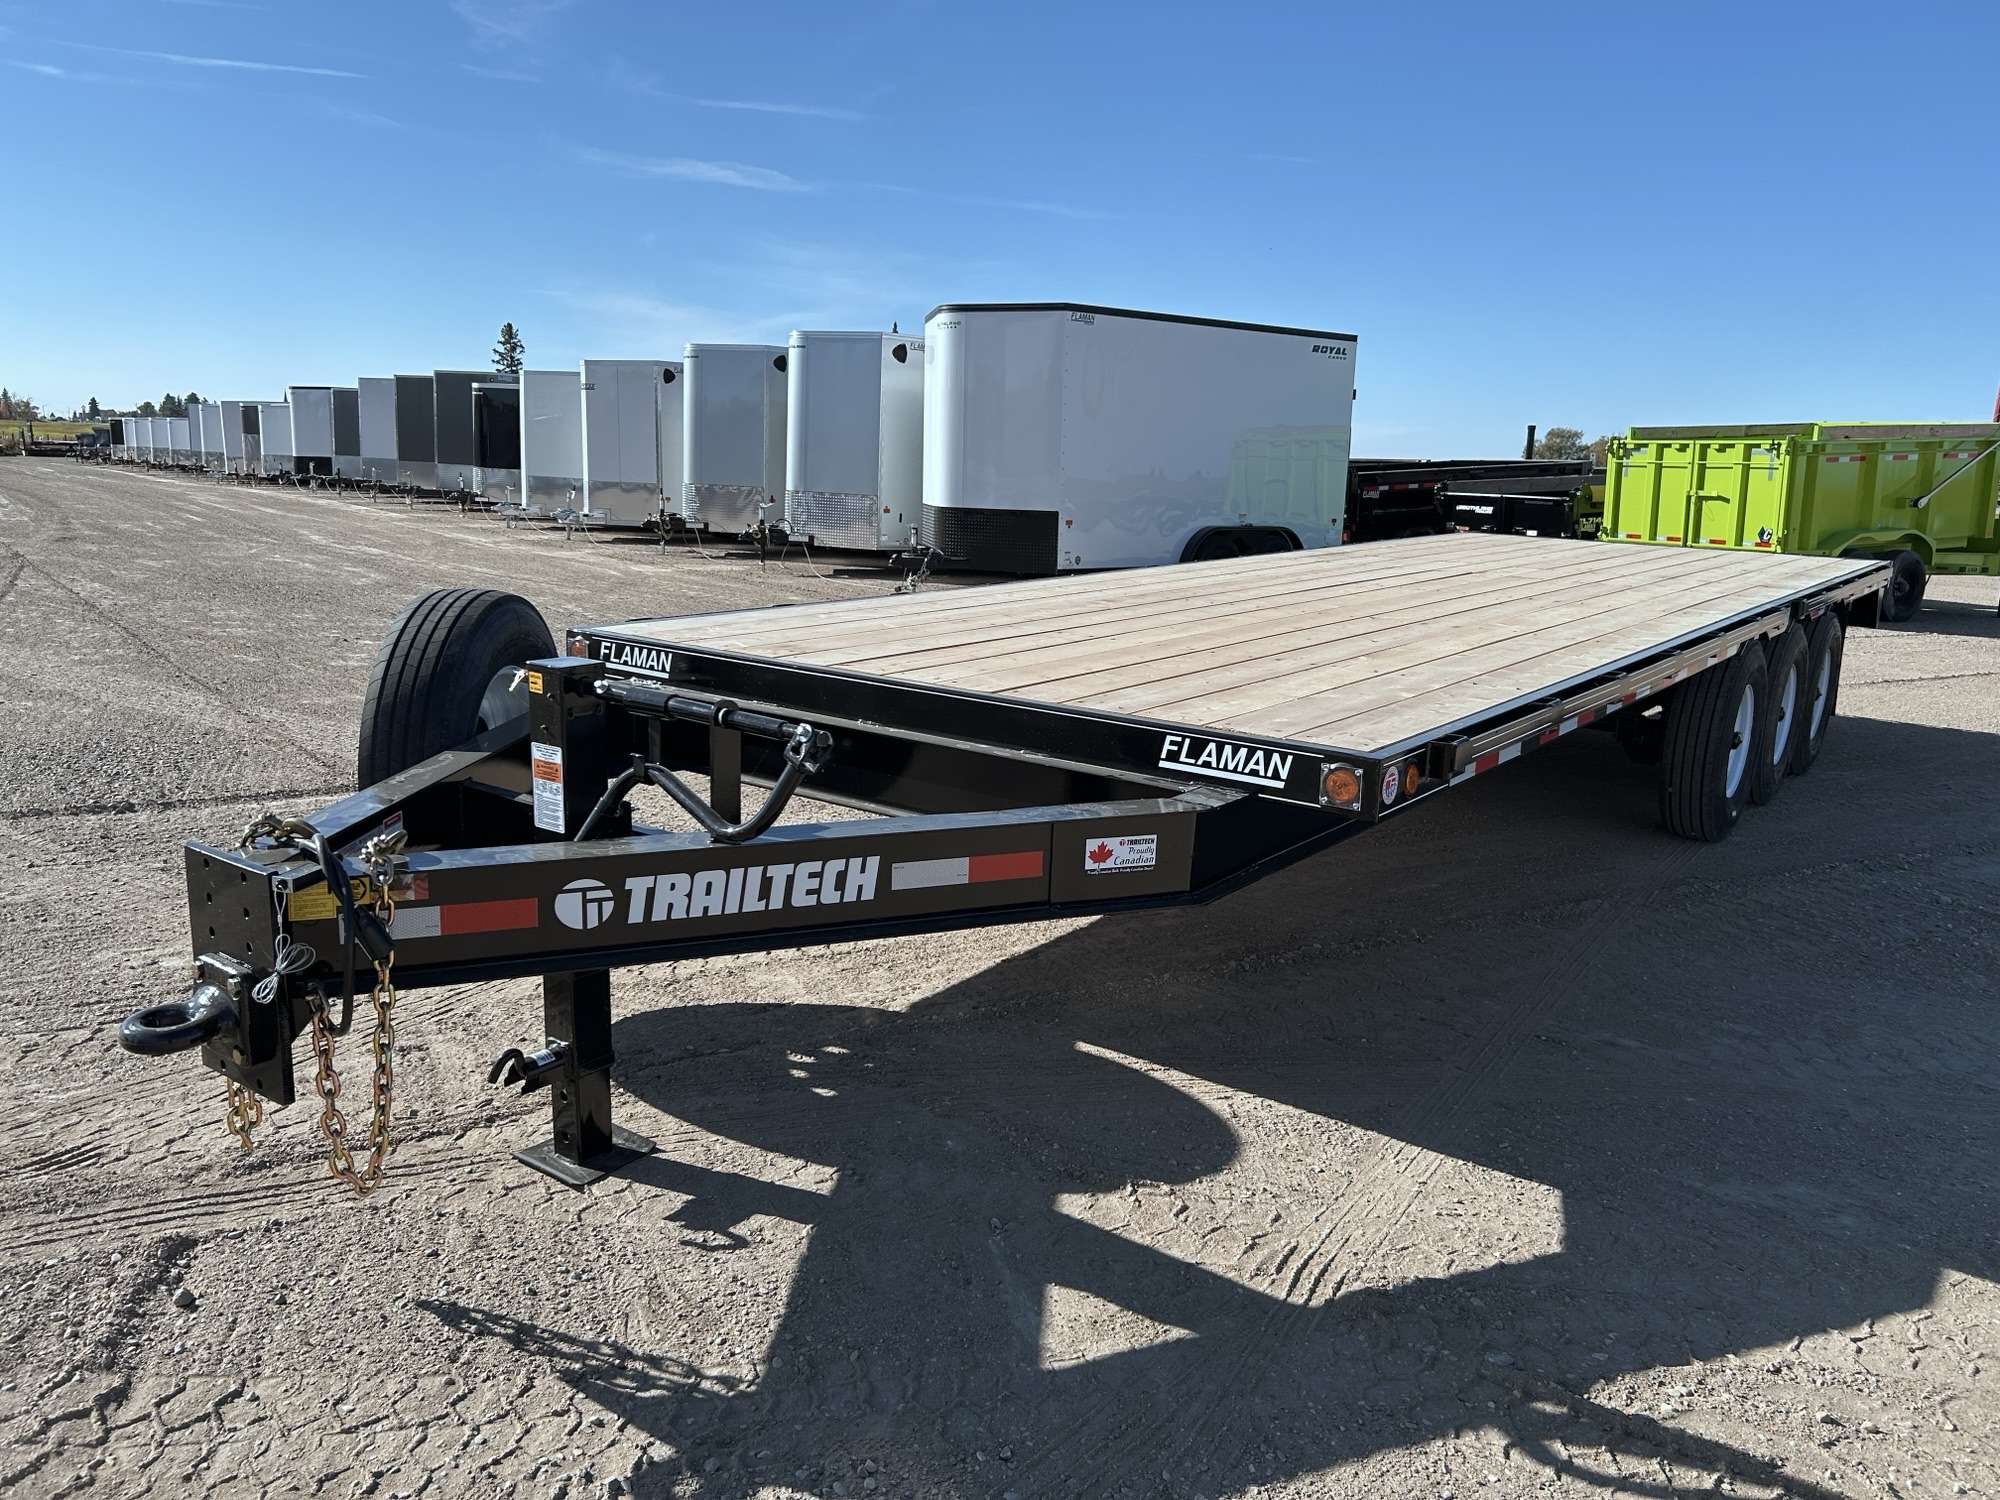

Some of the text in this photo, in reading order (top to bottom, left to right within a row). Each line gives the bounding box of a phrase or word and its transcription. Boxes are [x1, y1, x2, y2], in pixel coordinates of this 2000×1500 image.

[1312, 344, 1347, 355] ROYAL
[600, 641, 672, 672] FLAMAN
[1160, 735, 1293, 780] FLAMAN
[1127, 838, 1155, 846] TRAILTECH
[1128, 846, 1154, 855] Proudly
[1113, 855, 1154, 865] Canadian
[624, 855, 881, 924] TRAILTECH
